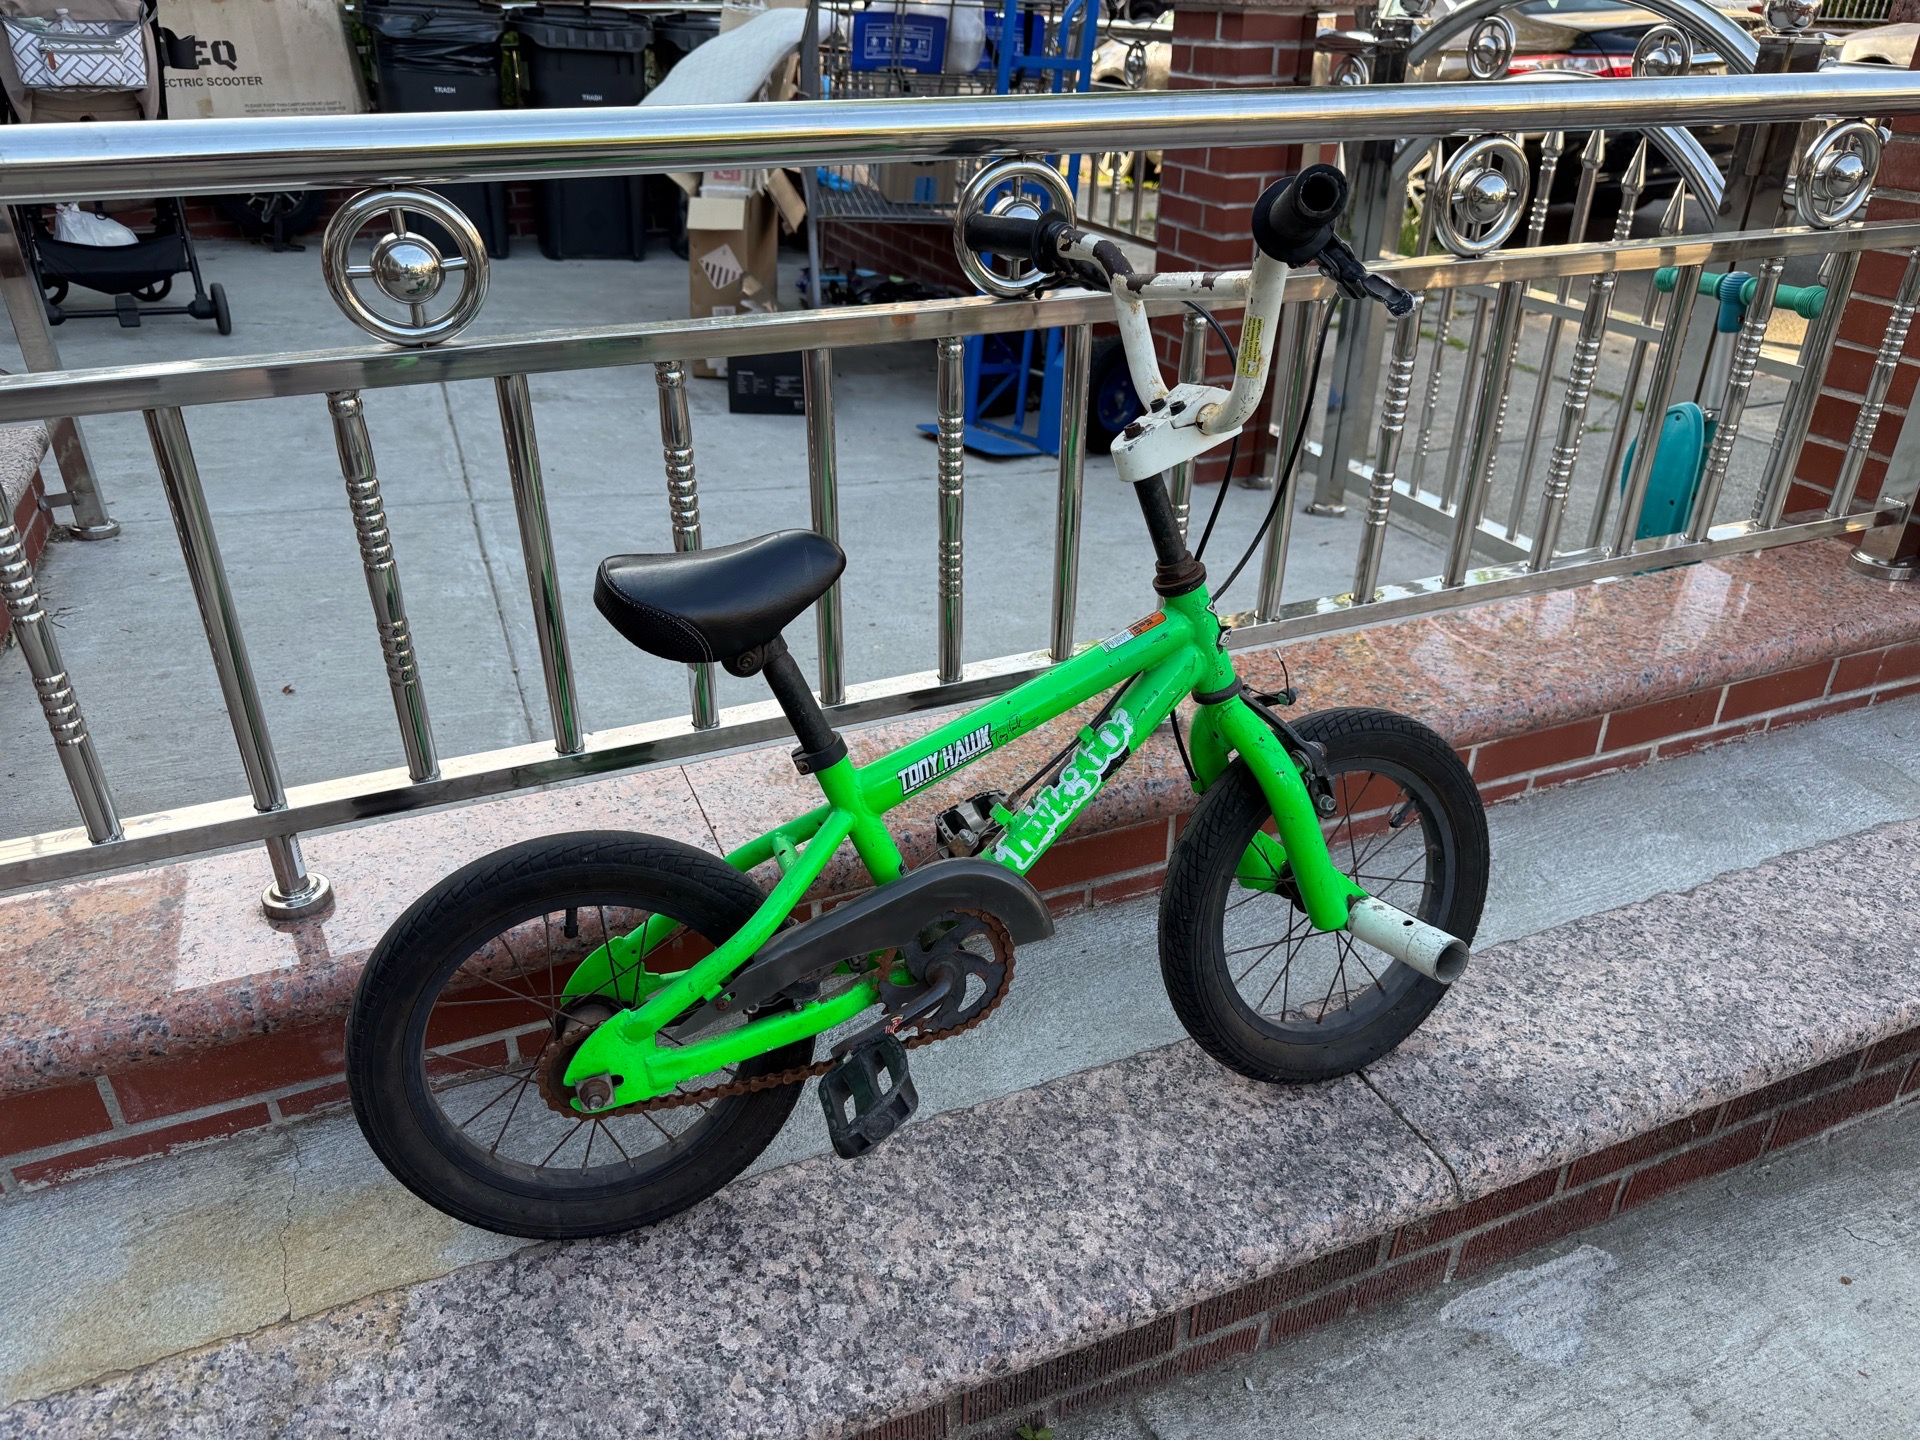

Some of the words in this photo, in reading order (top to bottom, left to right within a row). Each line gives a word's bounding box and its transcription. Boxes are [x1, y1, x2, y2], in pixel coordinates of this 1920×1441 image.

[206, 76, 264, 87] SCOOTER
[433, 86, 457, 94] TRASH
[898, 751, 940, 790] TONY
[941, 724, 993, 770] HAWK
